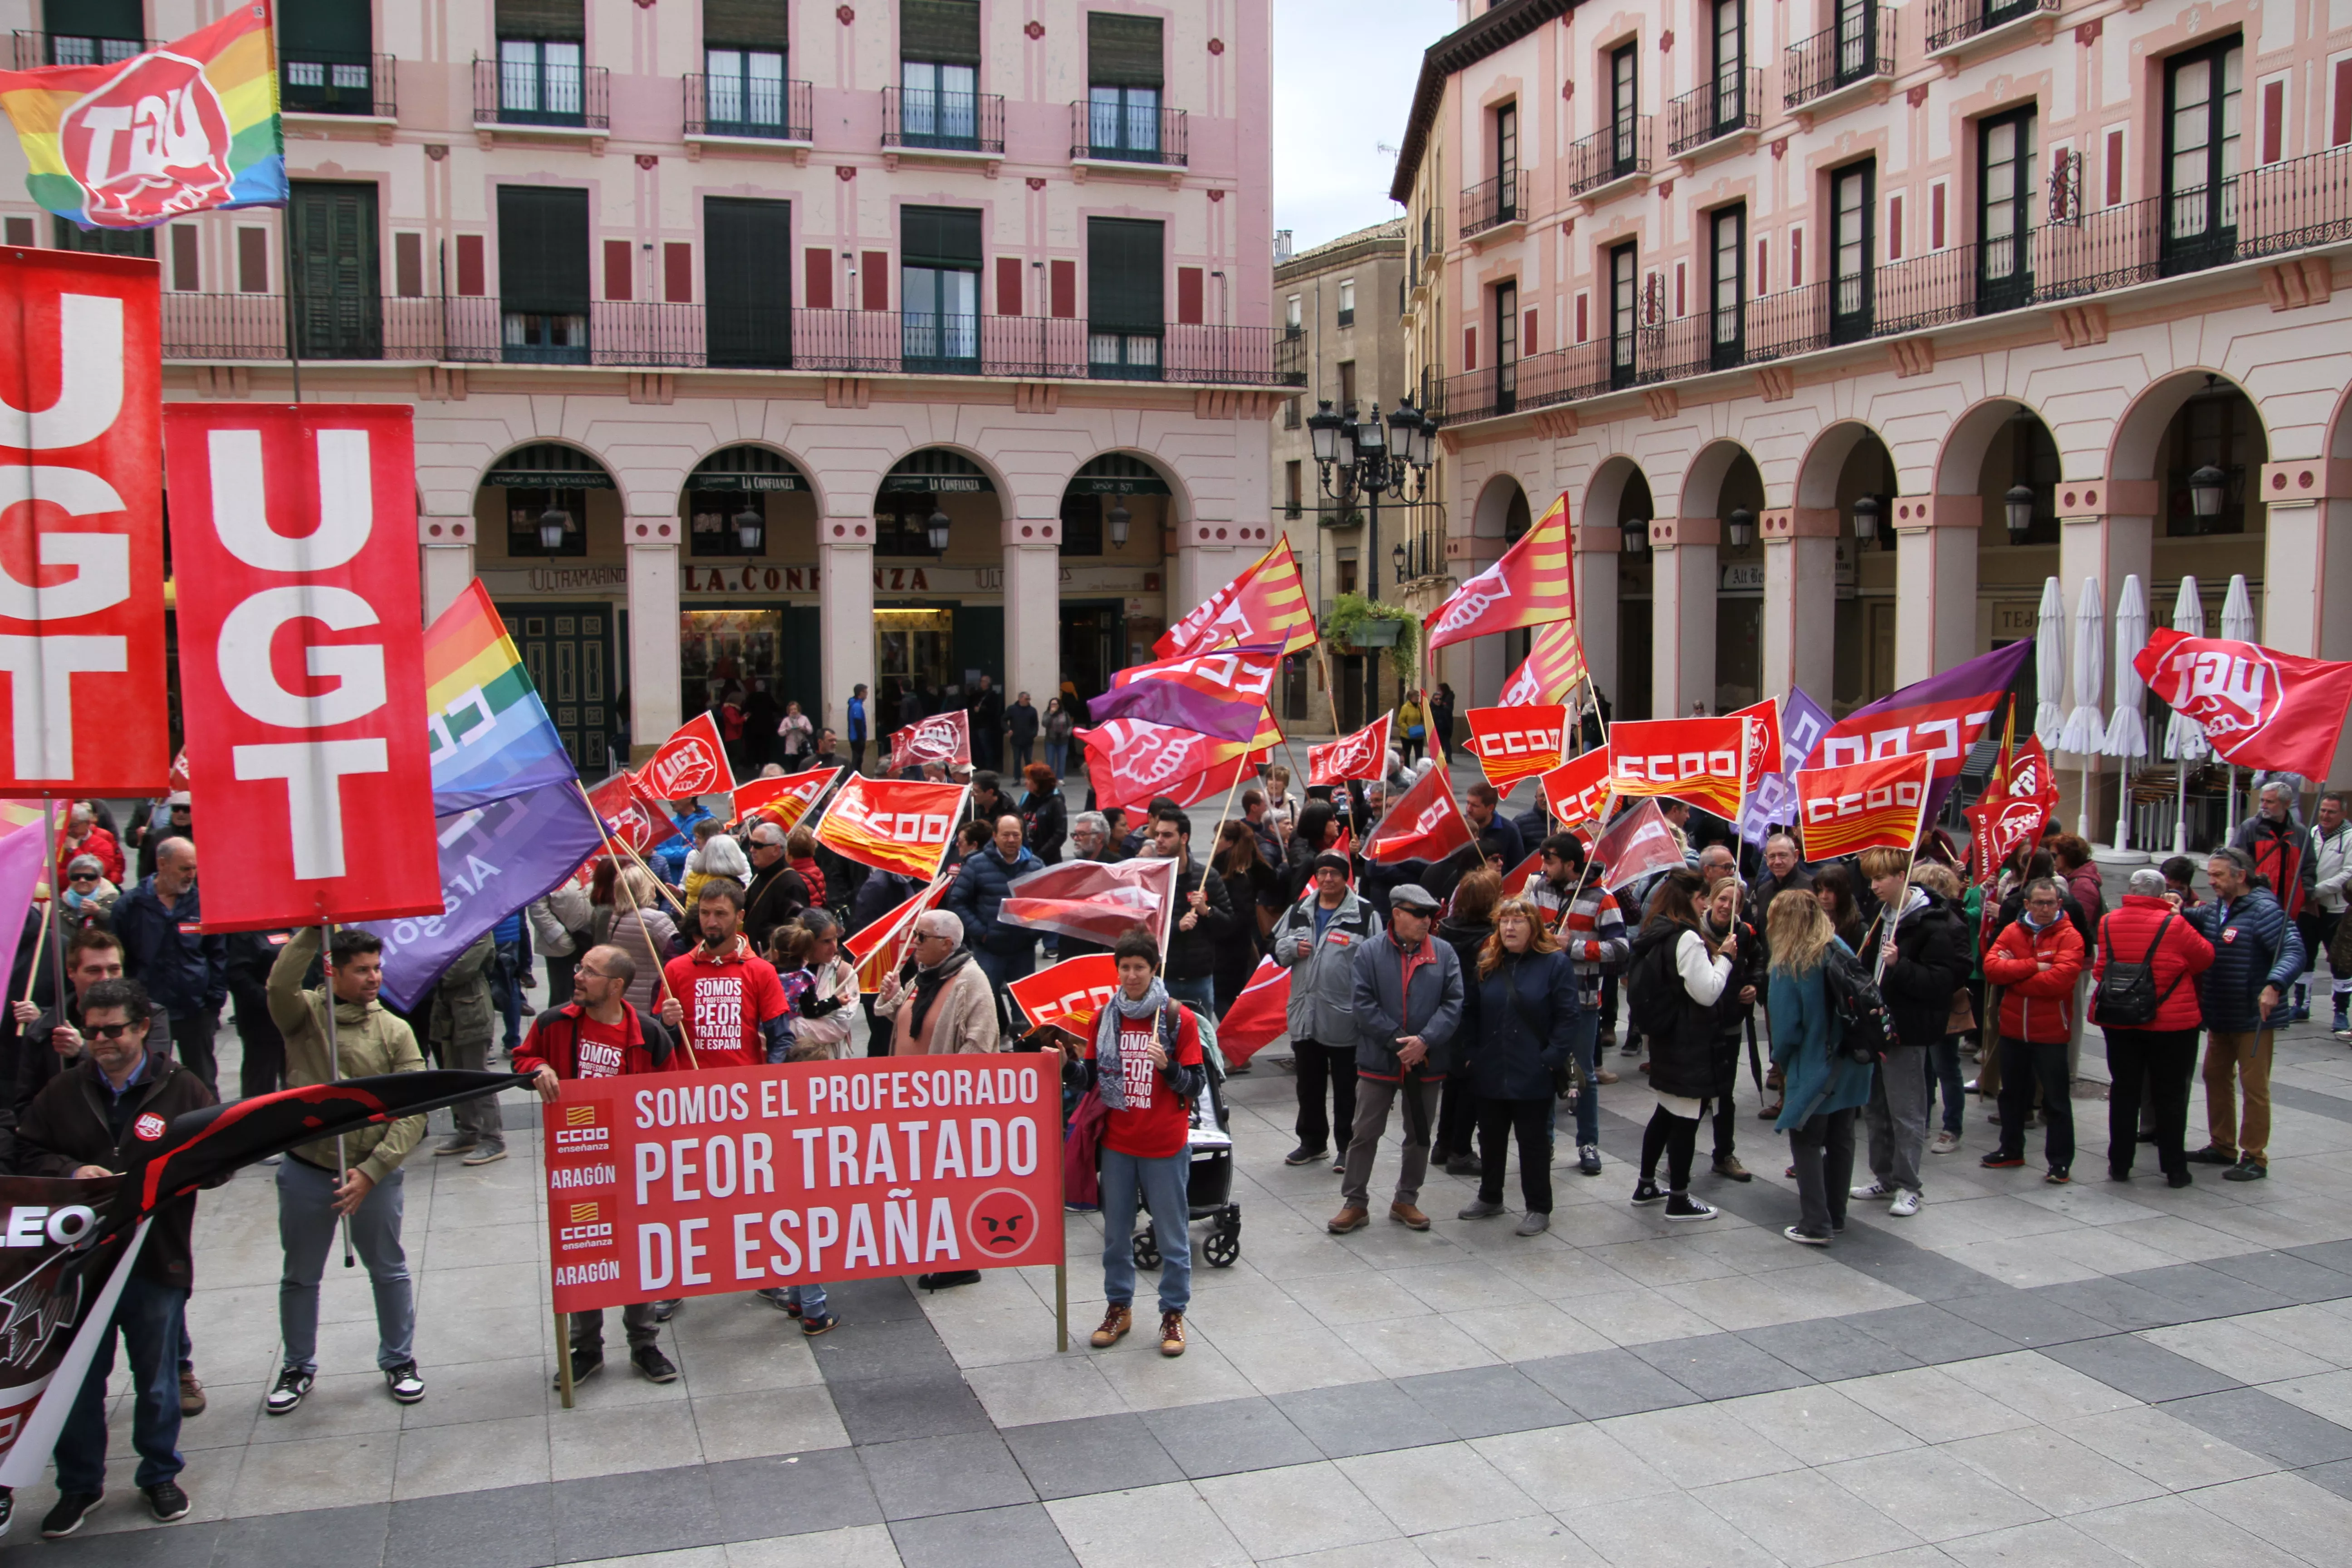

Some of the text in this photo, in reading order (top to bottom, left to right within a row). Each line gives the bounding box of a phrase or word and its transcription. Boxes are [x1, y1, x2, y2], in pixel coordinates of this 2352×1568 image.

[742, 476, 752, 489] LA
[754, 477, 794, 490] CONFIANZA
[941, 478, 980, 491] CONFIANZA
[532, 568, 626, 591] ULTRAMARINO
[684, 565, 726, 592] LA
[1733, 568, 1747, 584] Alt
[208, 429, 389, 880] UGT
[1479, 728, 1561, 757] CCOO
[657, 741, 705, 786] UGT
[1617, 750, 1736, 781] CCOO
[1807, 781, 1921, 823] CCOO
[836, 797, 949, 843] CCOO
[695, 980, 742, 997] SOMOS
[695, 1003, 741, 1025] PEOR
[1030, 985, 1118, 1023] CCO
[695, 1025, 741, 1038] TRATADO
[695, 1037, 741, 1050] DE ESPAÑA
[1120, 1033, 1153, 1051] OMO
[579, 1043, 622, 1068] OMOS
[1122, 1058, 1154, 1083] EOR
[636, 1067, 1038, 1129] SOMOS EL PROFESORADO
[1125, 1096, 1152, 1109] SPAÑA
[138, 1114, 165, 1132] UGT
[556, 1127, 608, 1143] CCOO
[558, 1142, 609, 1153] enseñanza
[636, 1116, 1038, 1205] PEOR TRATADO
[551, 1162, 616, 1189] ARAGÓN
[0, 1205, 96, 1247] EO
[560, 1222, 612, 1241] CCOO
[562, 1238, 612, 1251] enseñanza
[638, 1188, 960, 1291] DE ESPAÑA
[555, 1258, 620, 1286] ARAGÓN
